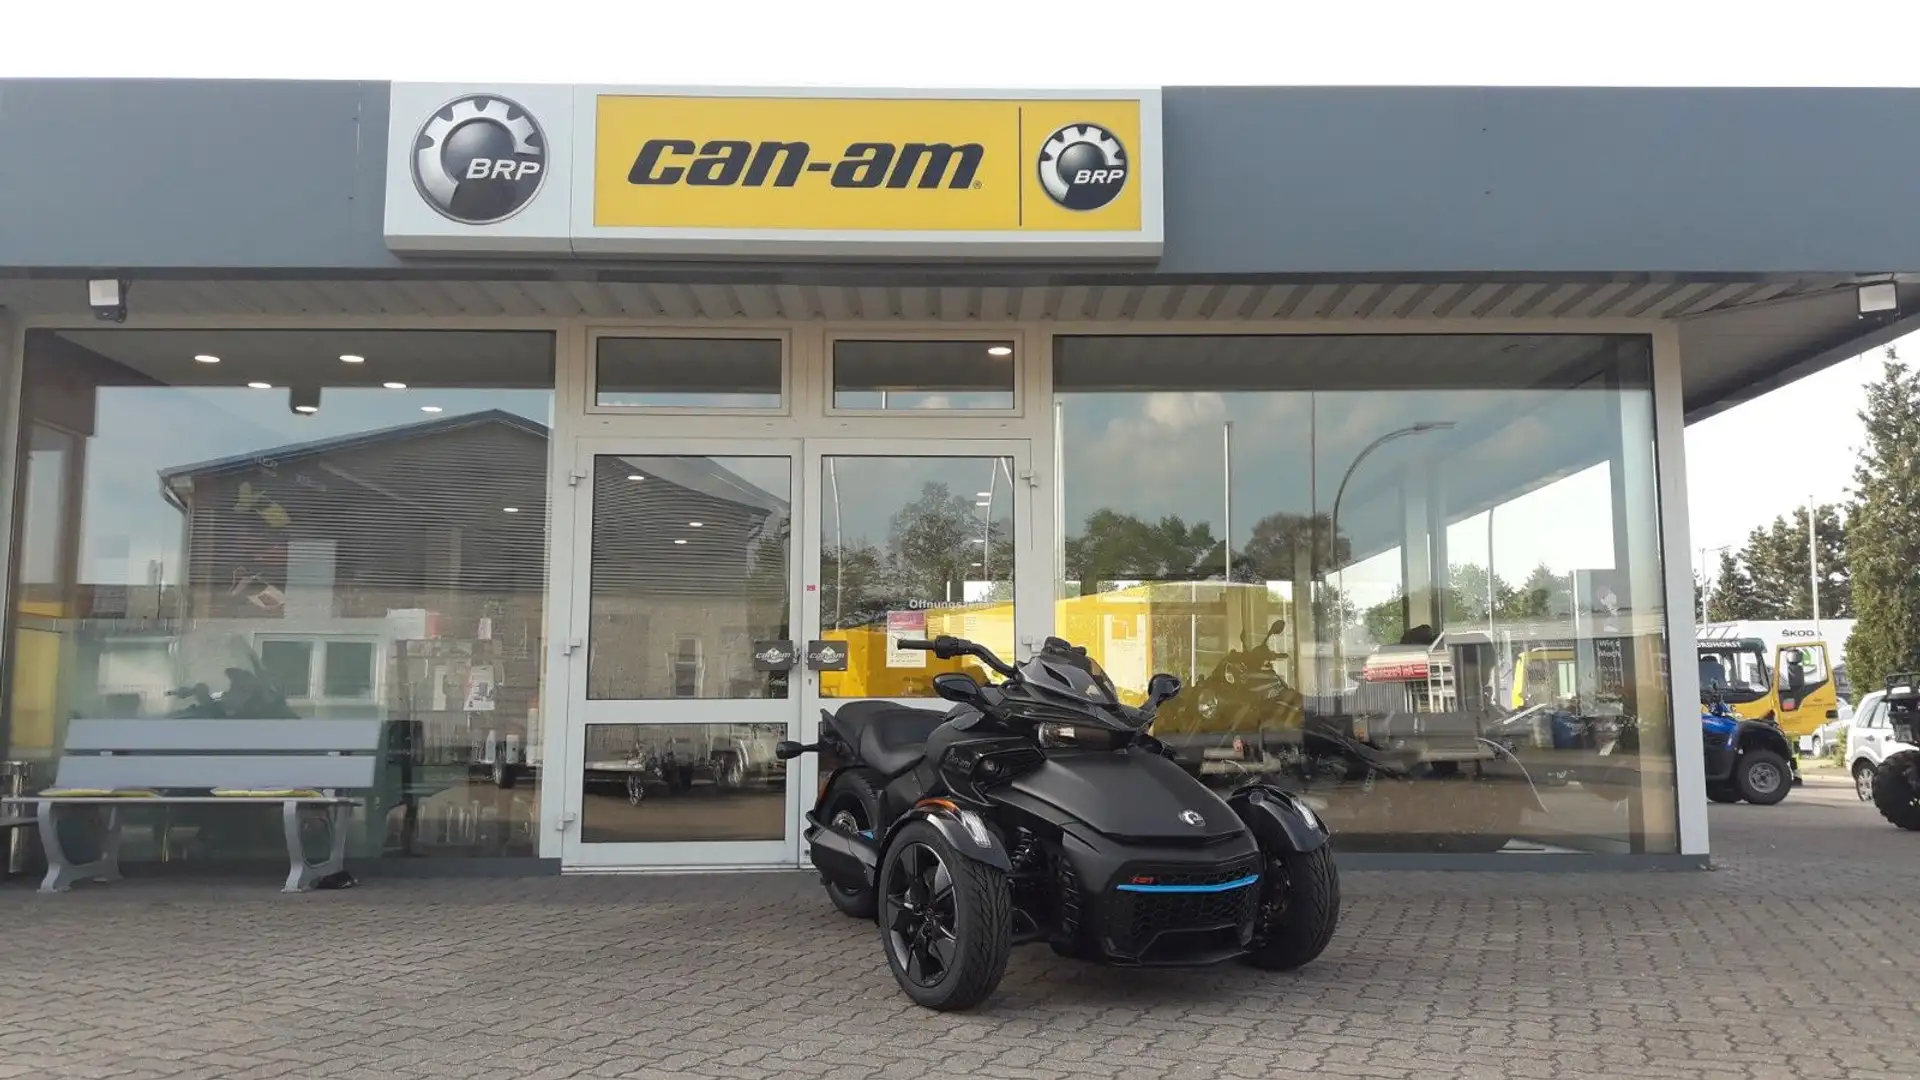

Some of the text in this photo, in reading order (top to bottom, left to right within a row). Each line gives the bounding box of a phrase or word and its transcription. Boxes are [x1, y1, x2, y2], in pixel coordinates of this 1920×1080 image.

[466, 158, 541, 181] BRP
[628, 139, 985, 189] can-am
[1074, 169, 1124, 185] BRP
